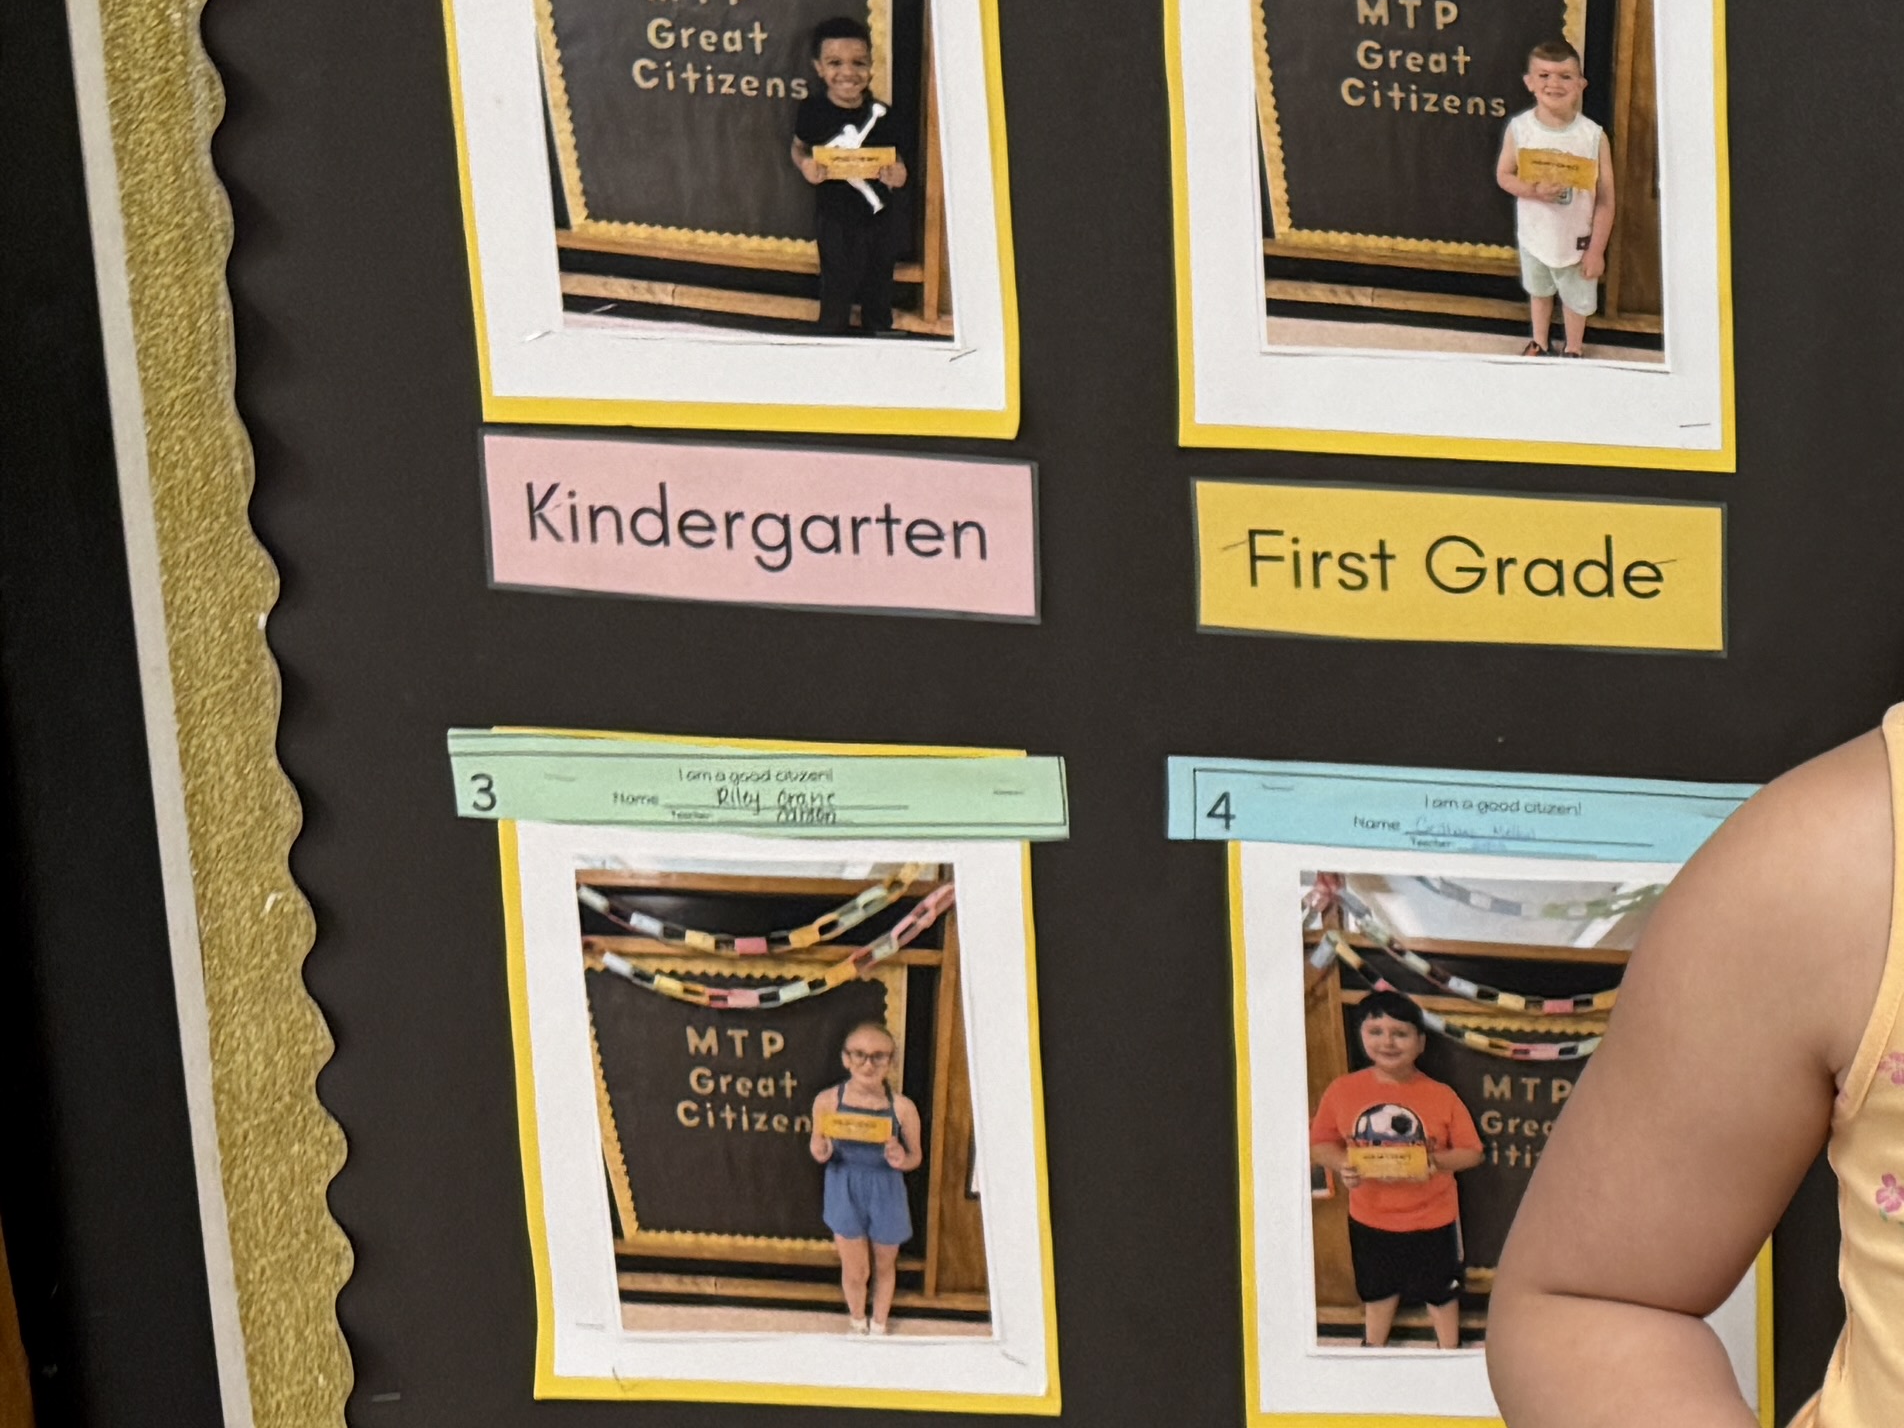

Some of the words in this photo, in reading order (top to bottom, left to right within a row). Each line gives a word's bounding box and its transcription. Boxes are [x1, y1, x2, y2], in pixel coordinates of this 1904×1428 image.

[646, 17, 769, 57] Great
[1356, 40, 1471, 76] Great
[631, 58, 809, 100] Citizens
[1341, 78, 1506, 119] Citizens
[527, 481, 988, 573] Kindergarten
[1247, 528, 1395, 592] First
[1425, 534, 1664, 598] Grade
[471, 773, 497, 813] 3
[1206, 791, 1236, 831] 4
[1354, 816, 1401, 831] Name
[686, 1026, 785, 1057] MTP
[689, 1067, 798, 1099] Great
[1483, 1074, 1574, 1103] MTP
[676, 1101, 812, 1133] Citizen
